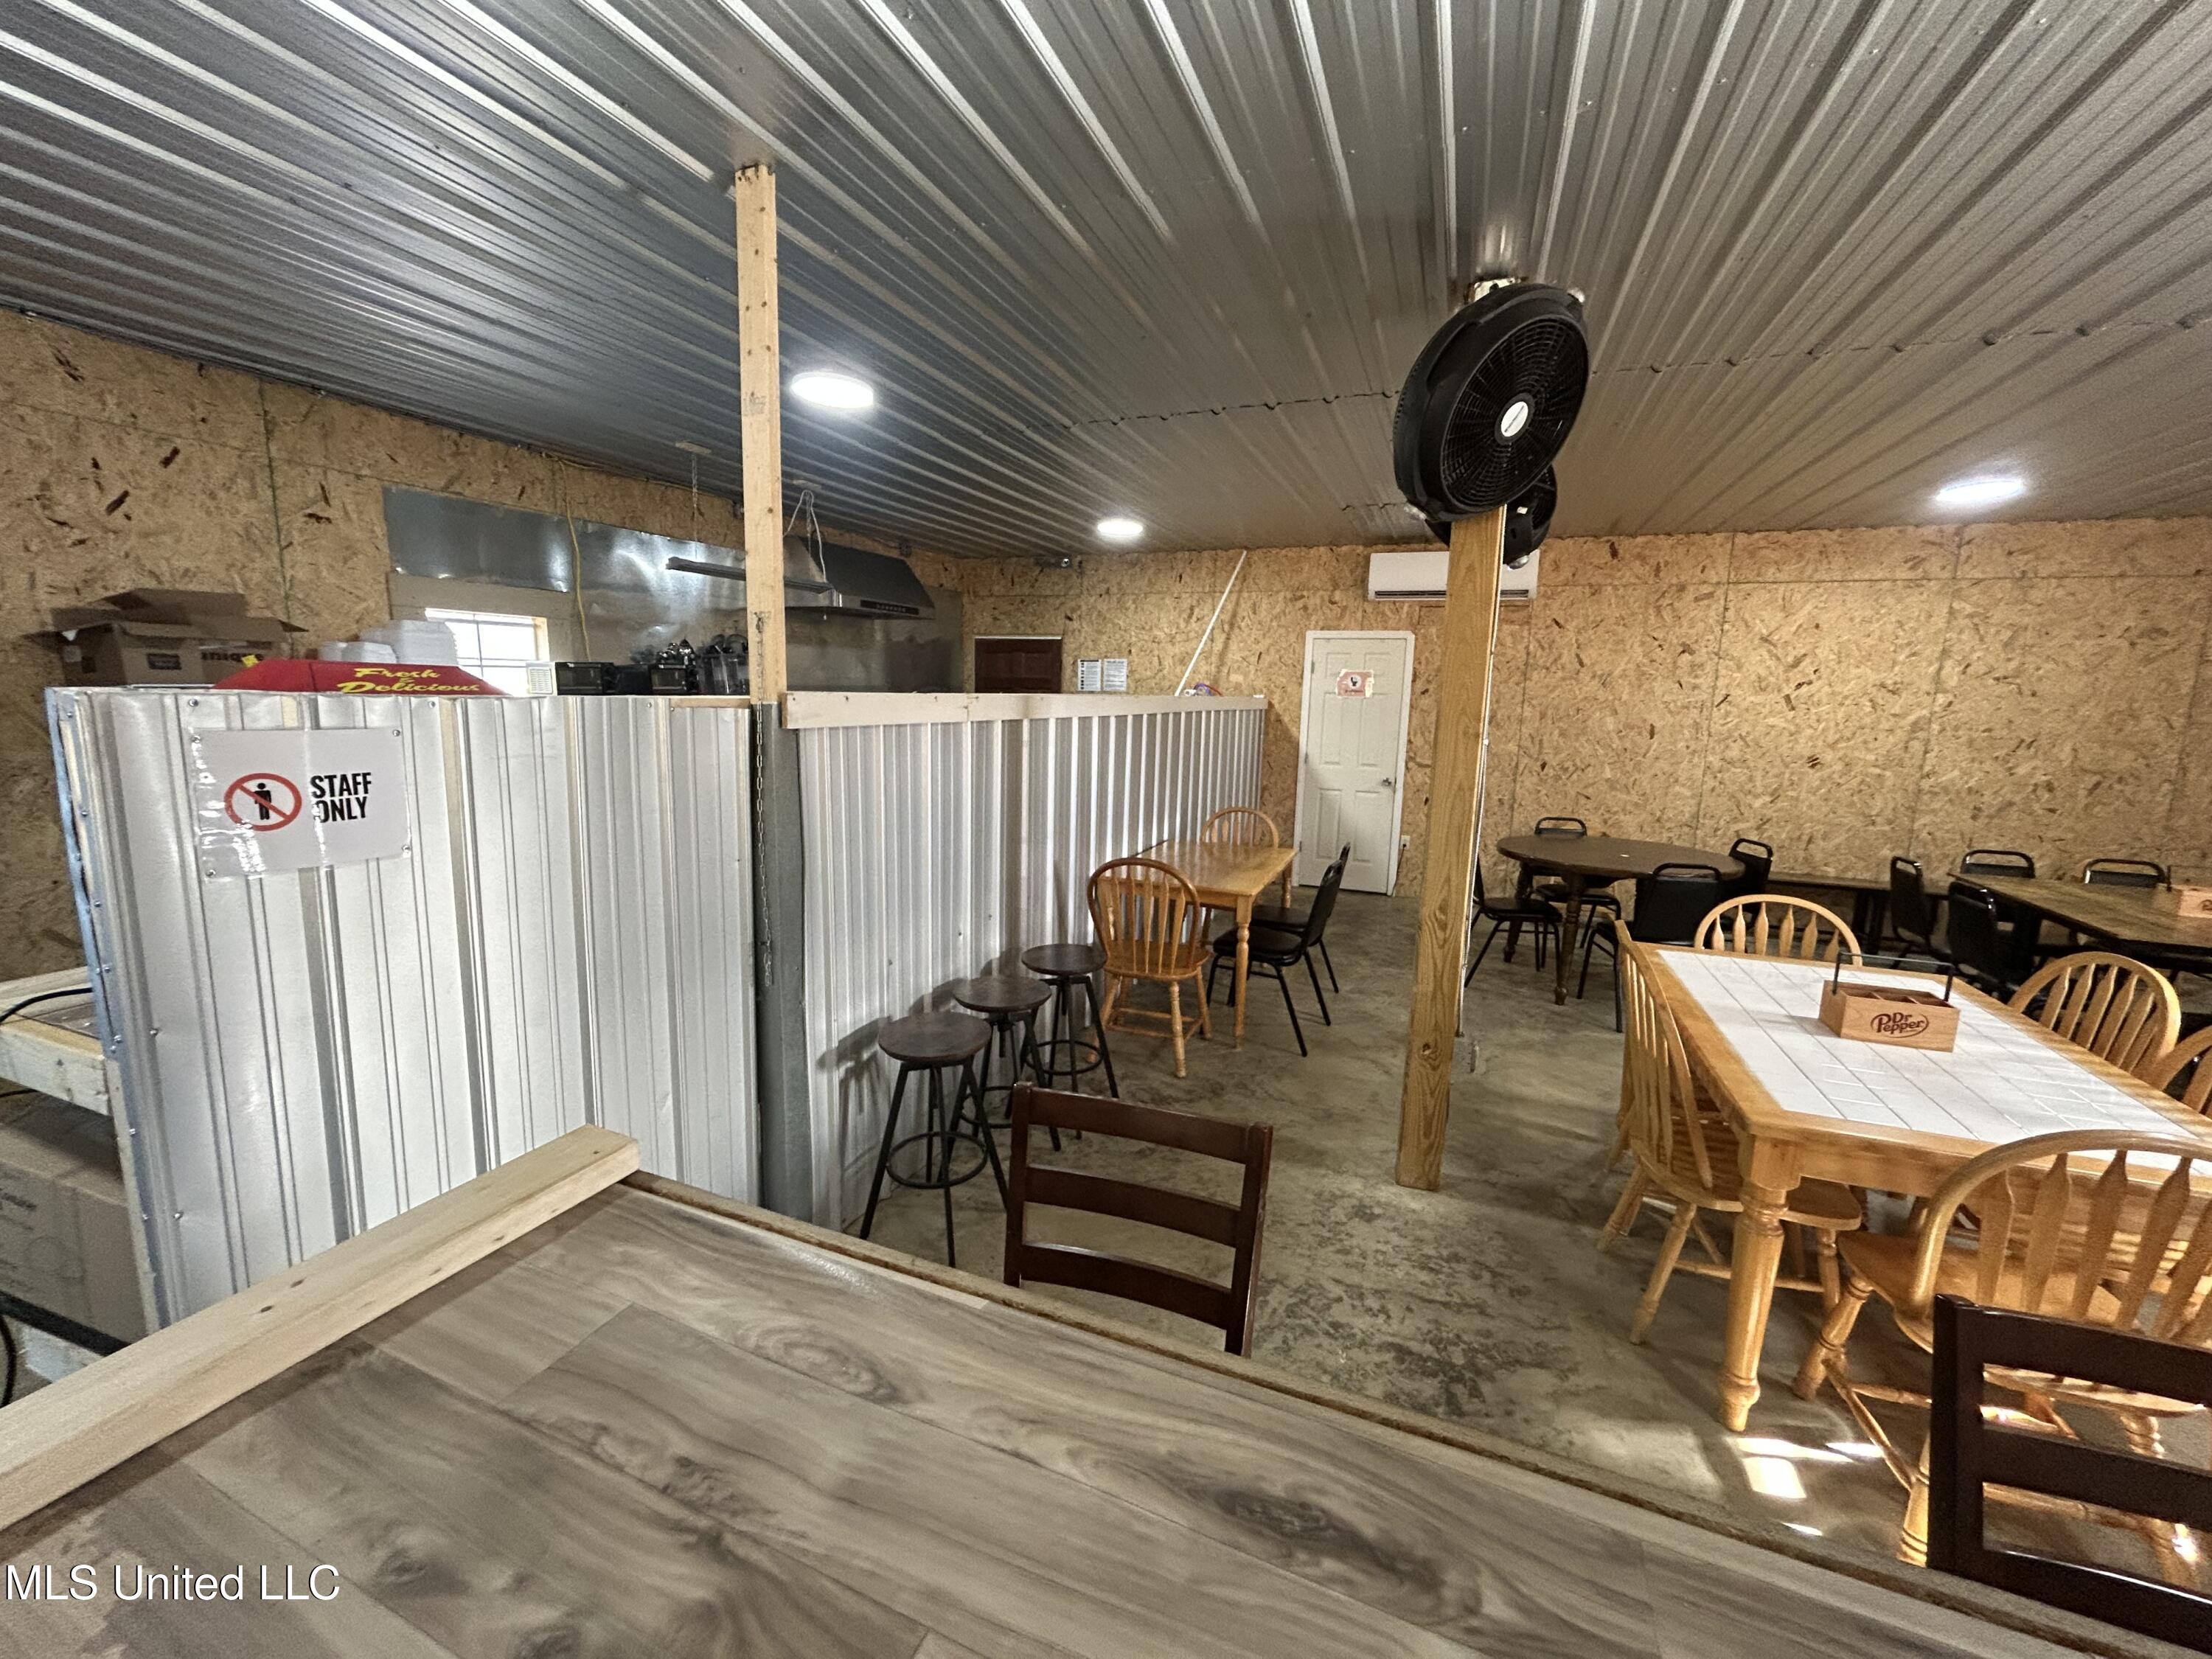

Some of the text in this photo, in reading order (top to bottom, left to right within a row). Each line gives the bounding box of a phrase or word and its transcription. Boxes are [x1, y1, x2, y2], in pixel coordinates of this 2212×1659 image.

[354, 667, 441, 678] Fresh
[337, 681, 481, 694] Delicious
[310, 772, 372, 799] STAFF
[313, 796, 367, 824] ONLY
[1871, 1013, 1925, 1034] Pepper
[1892, 1012, 1913, 1023] Dr
